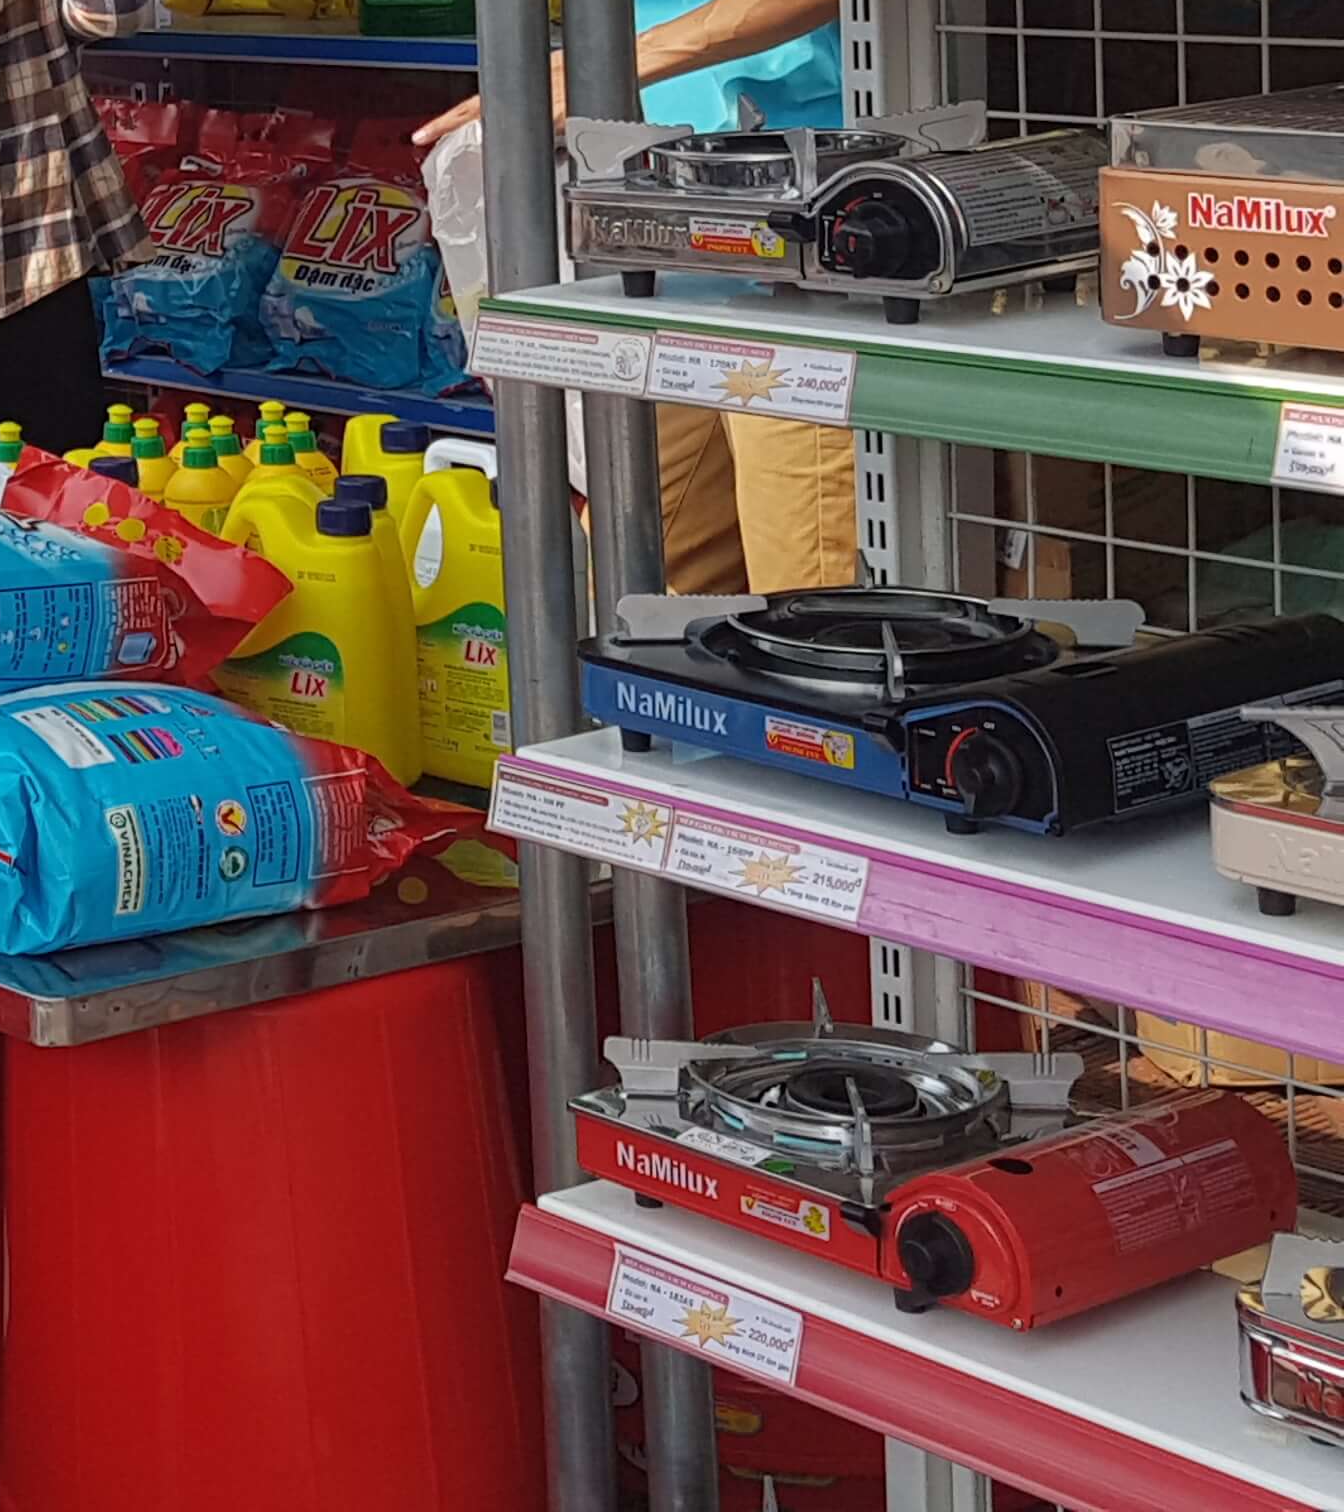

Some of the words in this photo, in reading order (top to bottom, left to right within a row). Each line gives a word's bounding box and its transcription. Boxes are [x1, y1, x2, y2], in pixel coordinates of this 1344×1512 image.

[1188, 191, 1328, 239] NaMilux
[616, 681, 729, 738] NaMilux
[118, 830, 131, 911] VINACHEM
[616, 1141, 721, 1201] NaMilux
